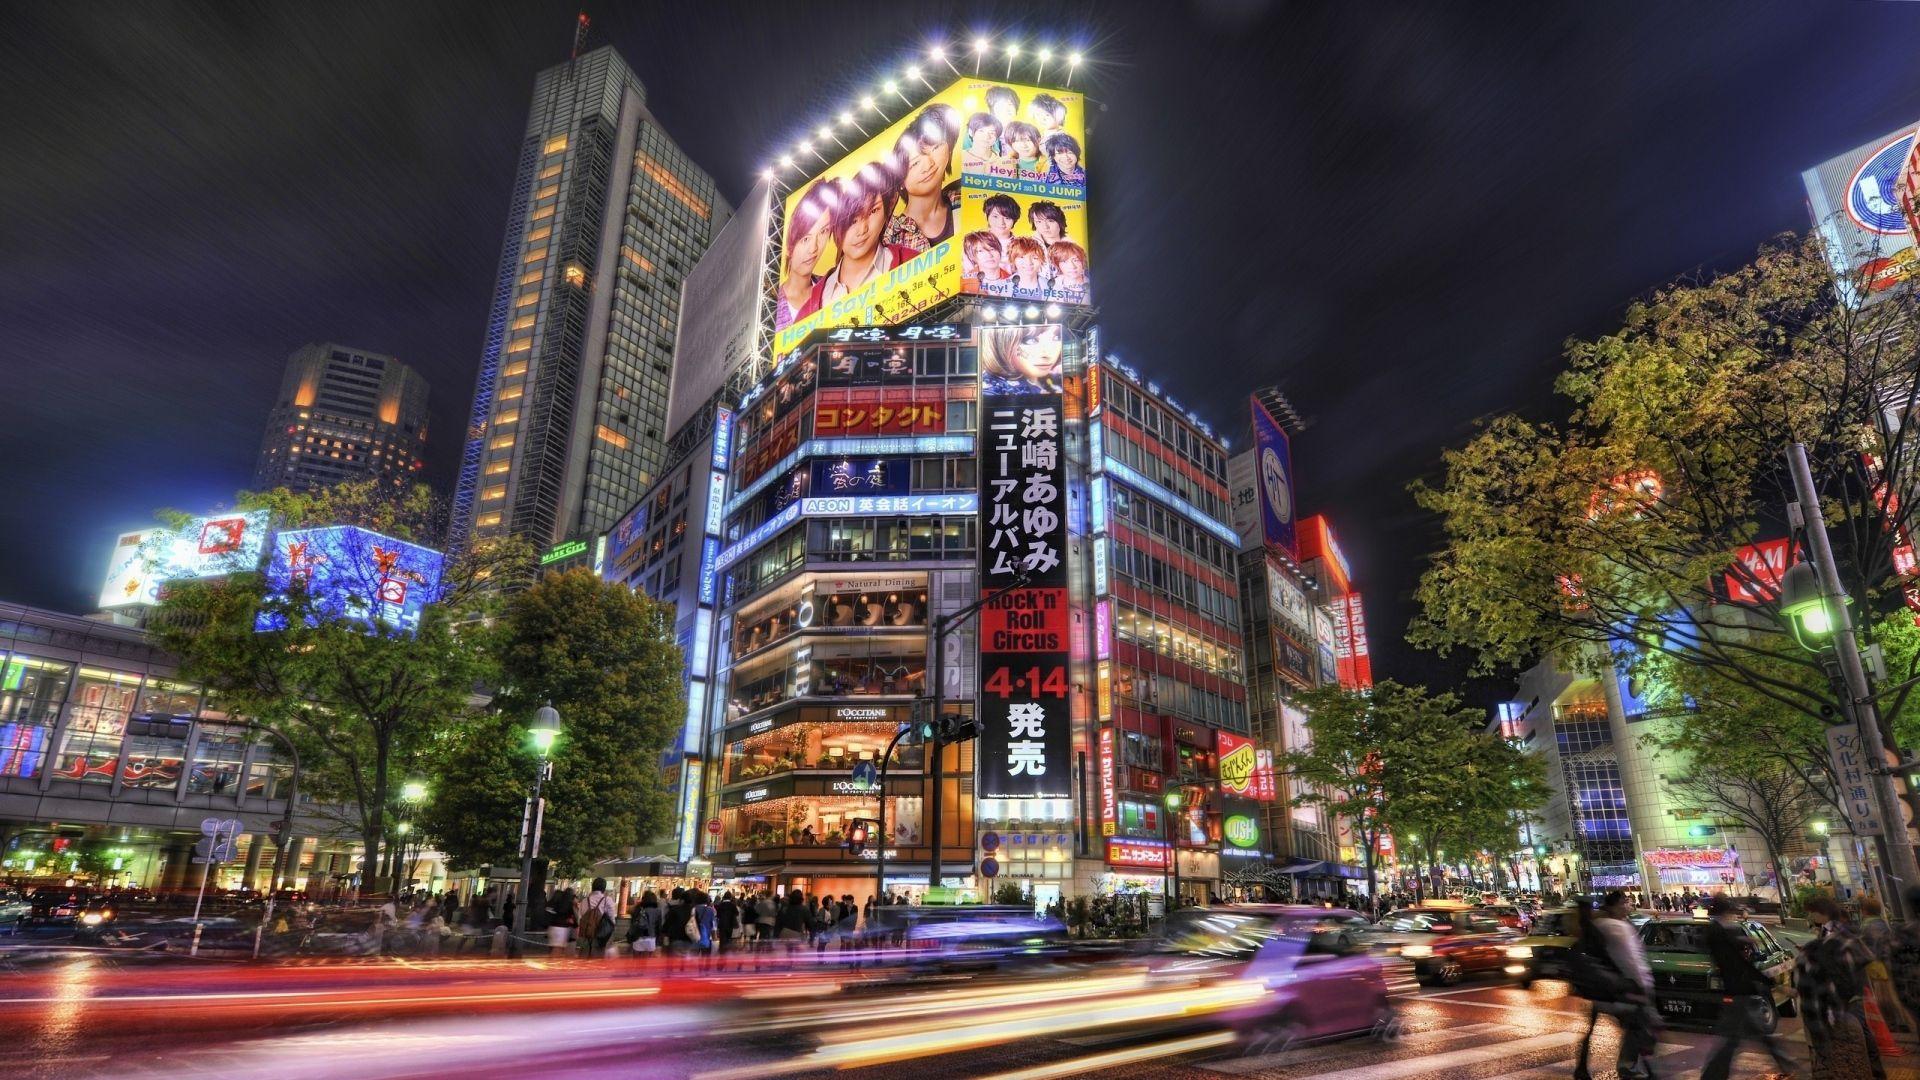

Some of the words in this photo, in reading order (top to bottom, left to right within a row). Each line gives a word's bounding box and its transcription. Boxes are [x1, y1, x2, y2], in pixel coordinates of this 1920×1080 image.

[990, 166, 1017, 177] Hey!
[1021, 170, 1046, 180] Say!
[965, 176, 992, 188] Hey!
[996, 180, 1022, 191] Say!
[1049, 187, 1083, 198] JUMP
[832, 282, 876, 319] Say!
[883, 242, 951, 293] JUMP
[980, 283, 1008, 294] Hey!
[1012, 285, 1039, 297] Say!
[1044, 289, 1070, 299] BEST
[817, 406, 943, 429] コンタクト
[989, 410, 1019, 575] ニューアルバム
[1021, 407, 1060, 574] 浜崎あゆみ
[806, 500, 851, 512] AEON
[859, 497, 973, 512] 英会話イーオン
[736, 516, 785, 556] 英会話イーオン
[542, 550, 565, 561] MARK
[566, 542, 587, 554] CITY
[847, 580, 881, 589] Natural
[885, 578, 916, 588] Dining
[988, 590, 1062, 610] Rock'n'
[1007, 610, 1045, 630] Roll
[993, 630, 1058, 650] Circus
[837, 709, 887, 717] L'OCCITANE
[1007, 702, 1047, 777] 発売
[1833, 734, 1870, 818] 文化村通り
[1228, 818, 1255, 840] LUSH
